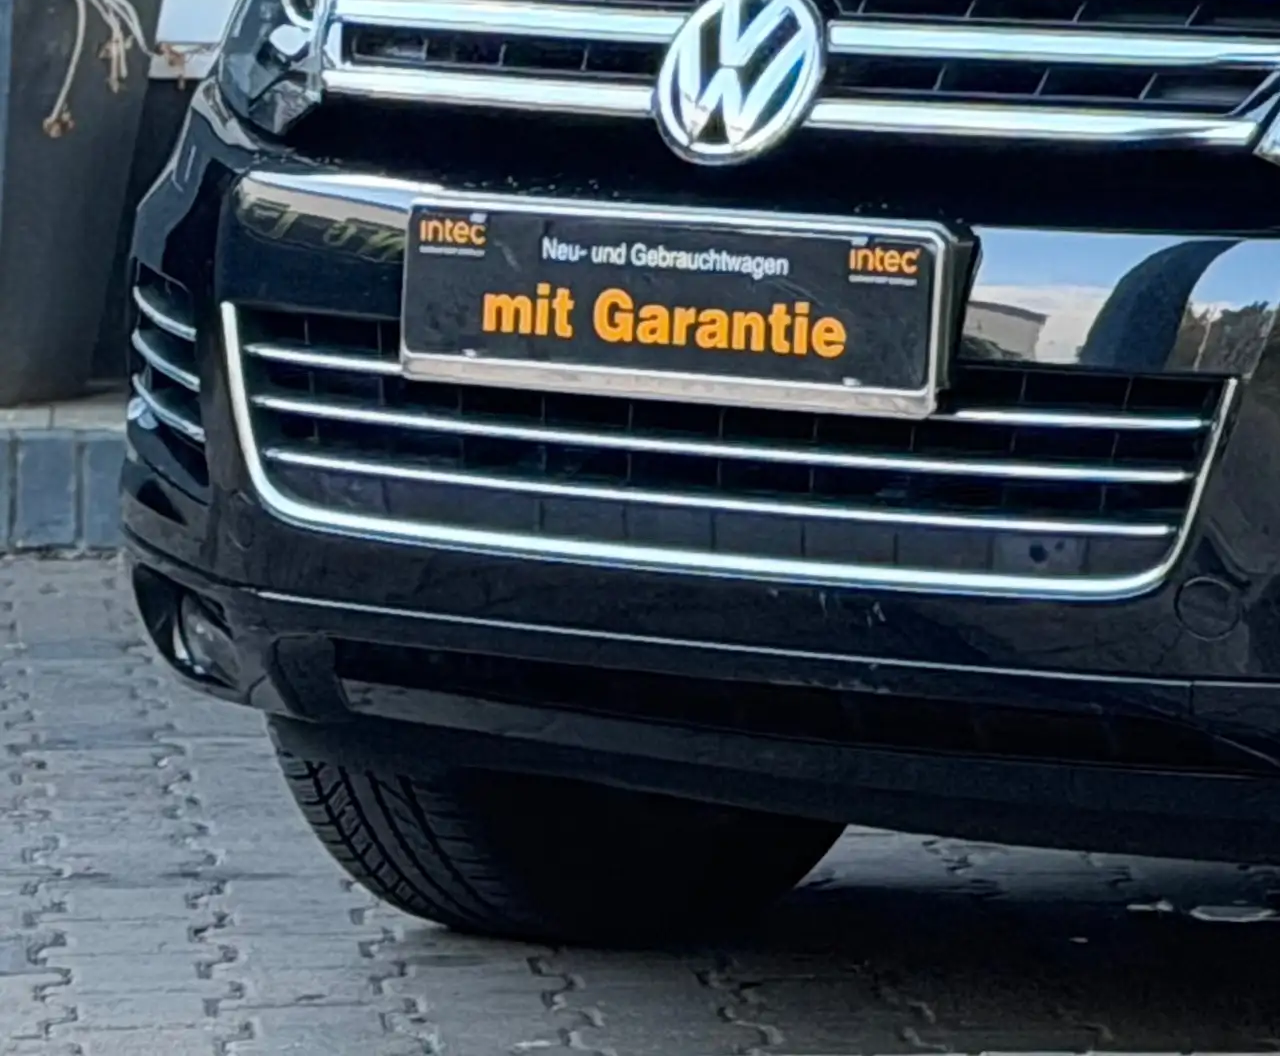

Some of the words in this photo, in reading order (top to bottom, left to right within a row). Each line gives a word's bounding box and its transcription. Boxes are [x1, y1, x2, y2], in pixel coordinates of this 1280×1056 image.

[420, 218, 487, 246] intec
[541, 235, 588, 262] Neu-
[590, 241, 627, 266] und
[630, 242, 790, 281] Gebrauchtwagen
[849, 246, 918, 275] intec
[482, 282, 575, 339] mit
[592, 287, 848, 358] Garantie
